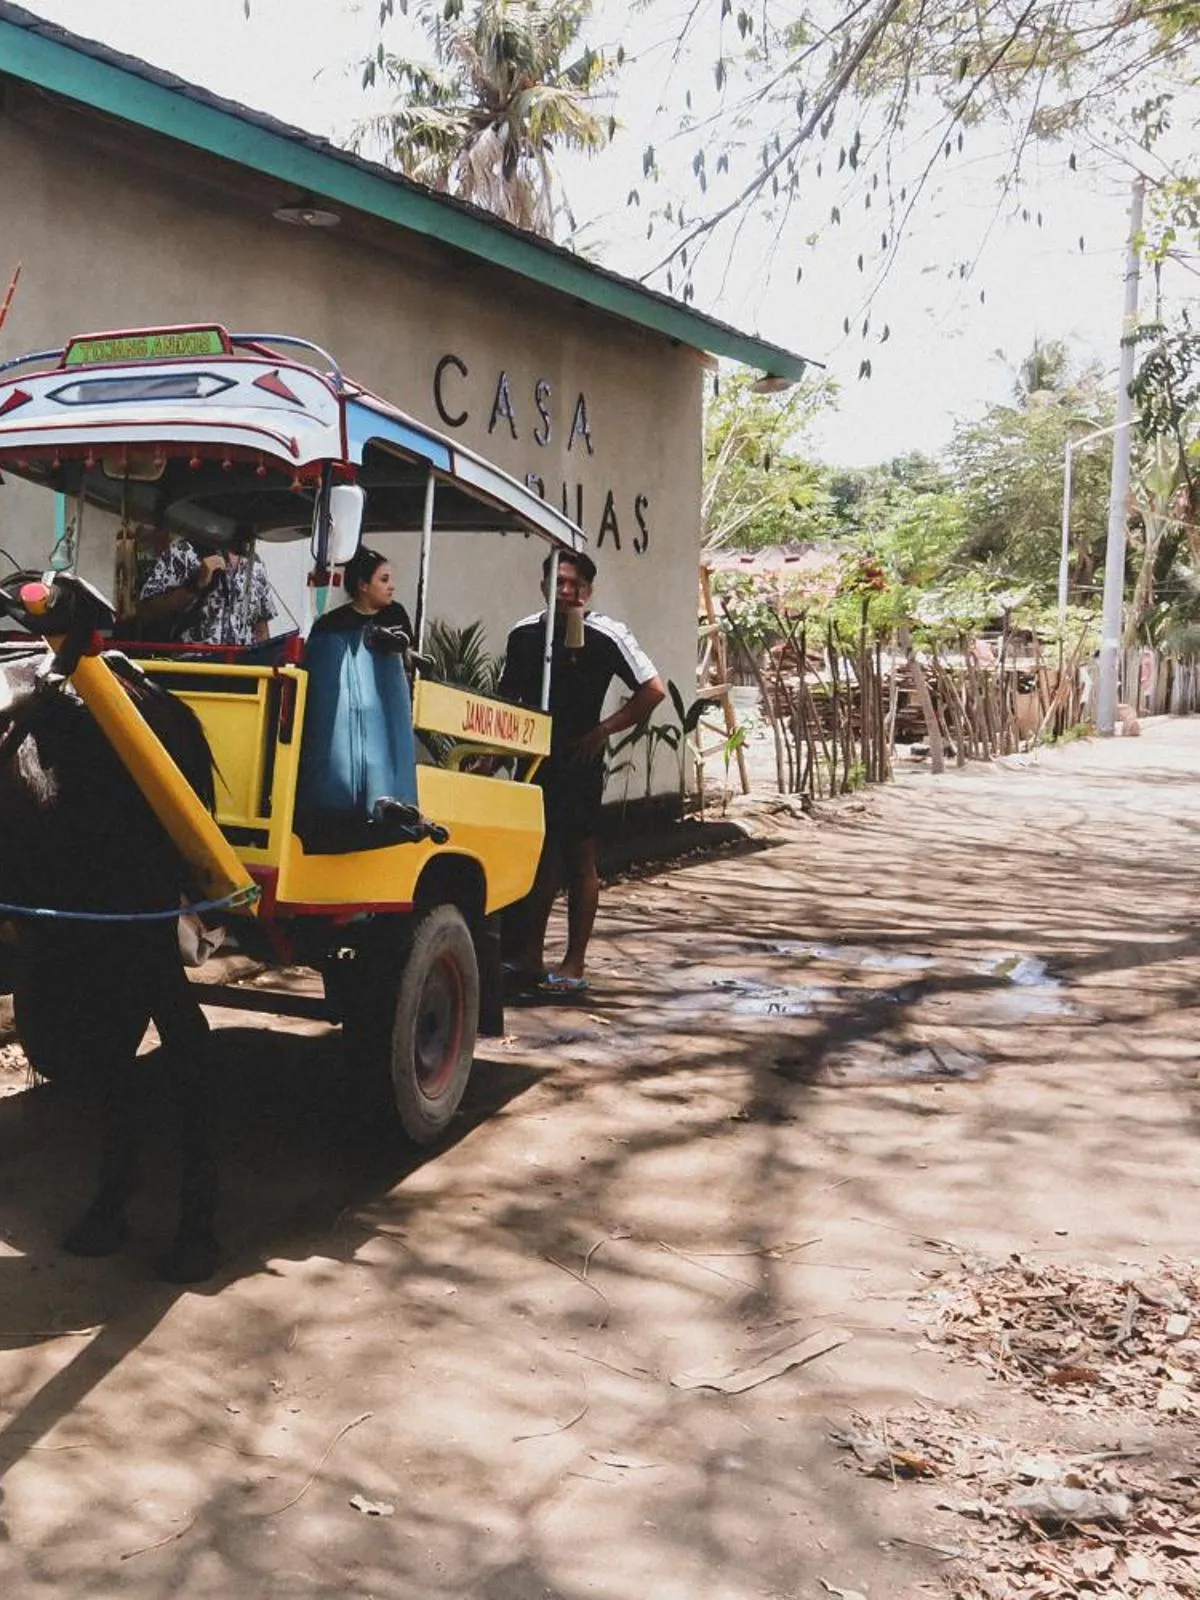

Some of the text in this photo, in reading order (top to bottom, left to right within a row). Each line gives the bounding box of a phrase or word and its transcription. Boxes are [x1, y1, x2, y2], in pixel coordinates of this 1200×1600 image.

[433, 354, 594, 456] CASA
[462, 699, 493, 737] JANUR
[522, 718, 536, 745] 27
